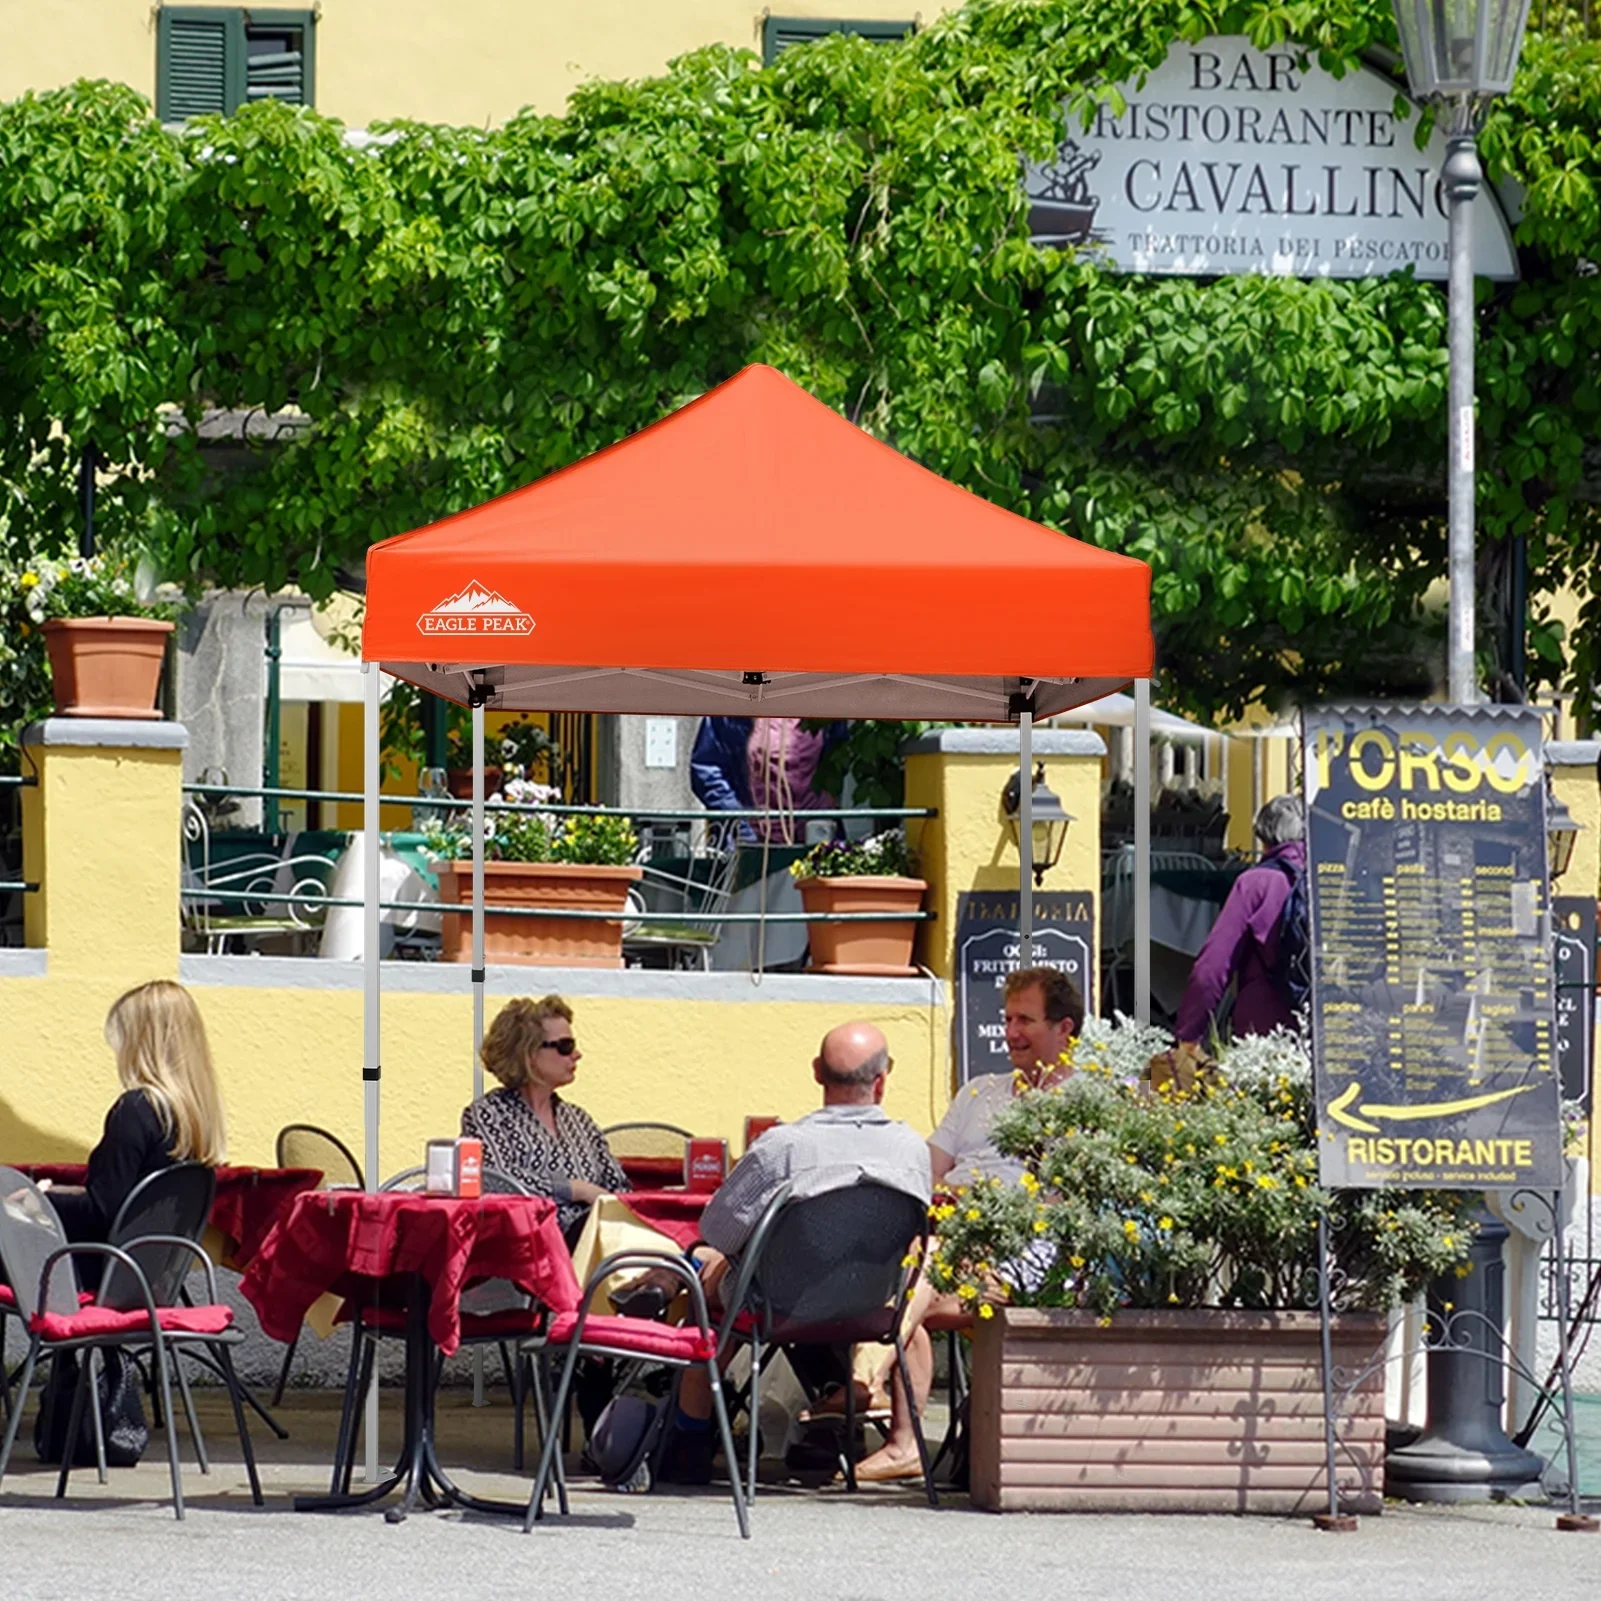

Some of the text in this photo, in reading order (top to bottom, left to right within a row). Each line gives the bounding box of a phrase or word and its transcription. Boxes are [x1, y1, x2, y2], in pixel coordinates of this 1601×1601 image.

[1190, 52, 1300, 92] BAR
[1091, 102, 1396, 148] RISTORANTE
[1128, 233, 1265, 256] TRATTORIA
[1278, 238, 1320, 257] DEI
[425, 618, 477, 631] EAGLE
[1342, 798, 1502, 822] cafè hostaria
[1347, 1138, 1533, 1166] RISTORANTE
